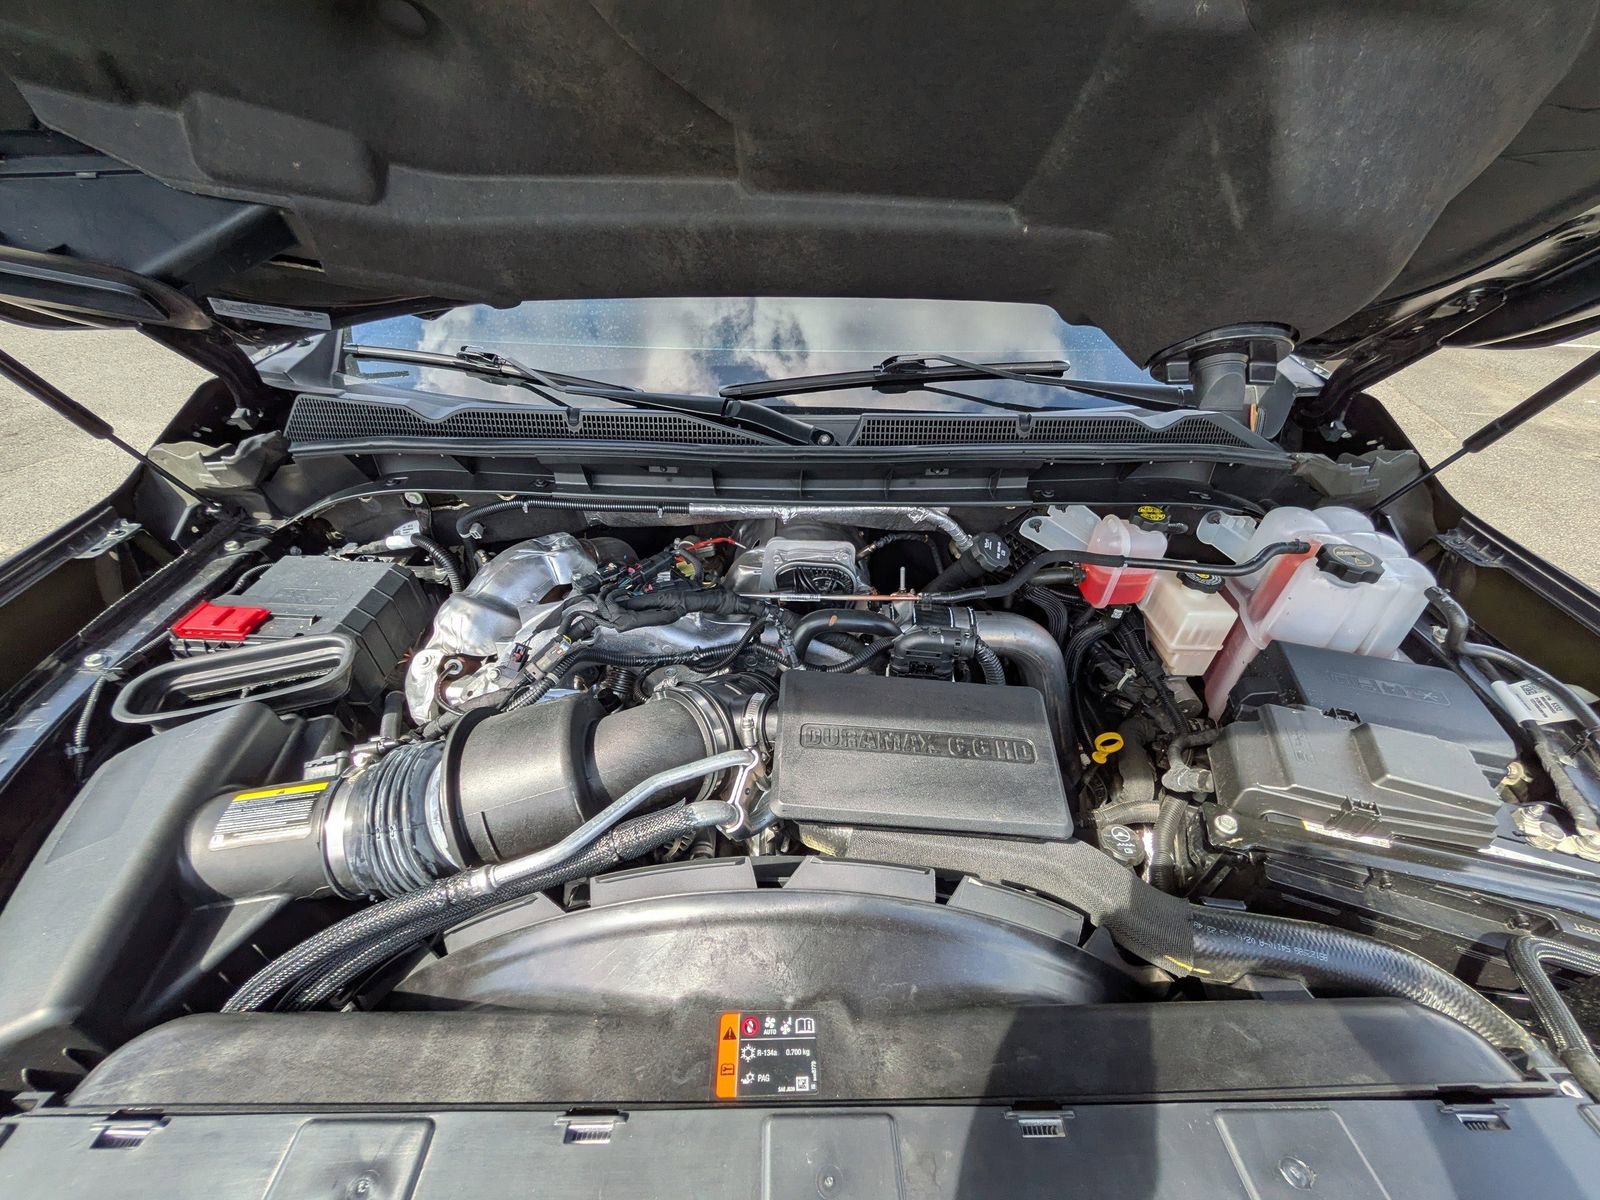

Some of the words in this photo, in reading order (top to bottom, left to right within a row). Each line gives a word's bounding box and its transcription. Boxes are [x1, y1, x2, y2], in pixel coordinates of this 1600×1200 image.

[804, 726, 935, 754] DURAMAX
[947, 737, 990, 758] 6.6
[756, 1049, 778, 1057] R-134a
[785, 1048, 802, 1056] 0.700
[802, 1048, 811, 1057] kg
[757, 1073, 770, 1082] PAG
